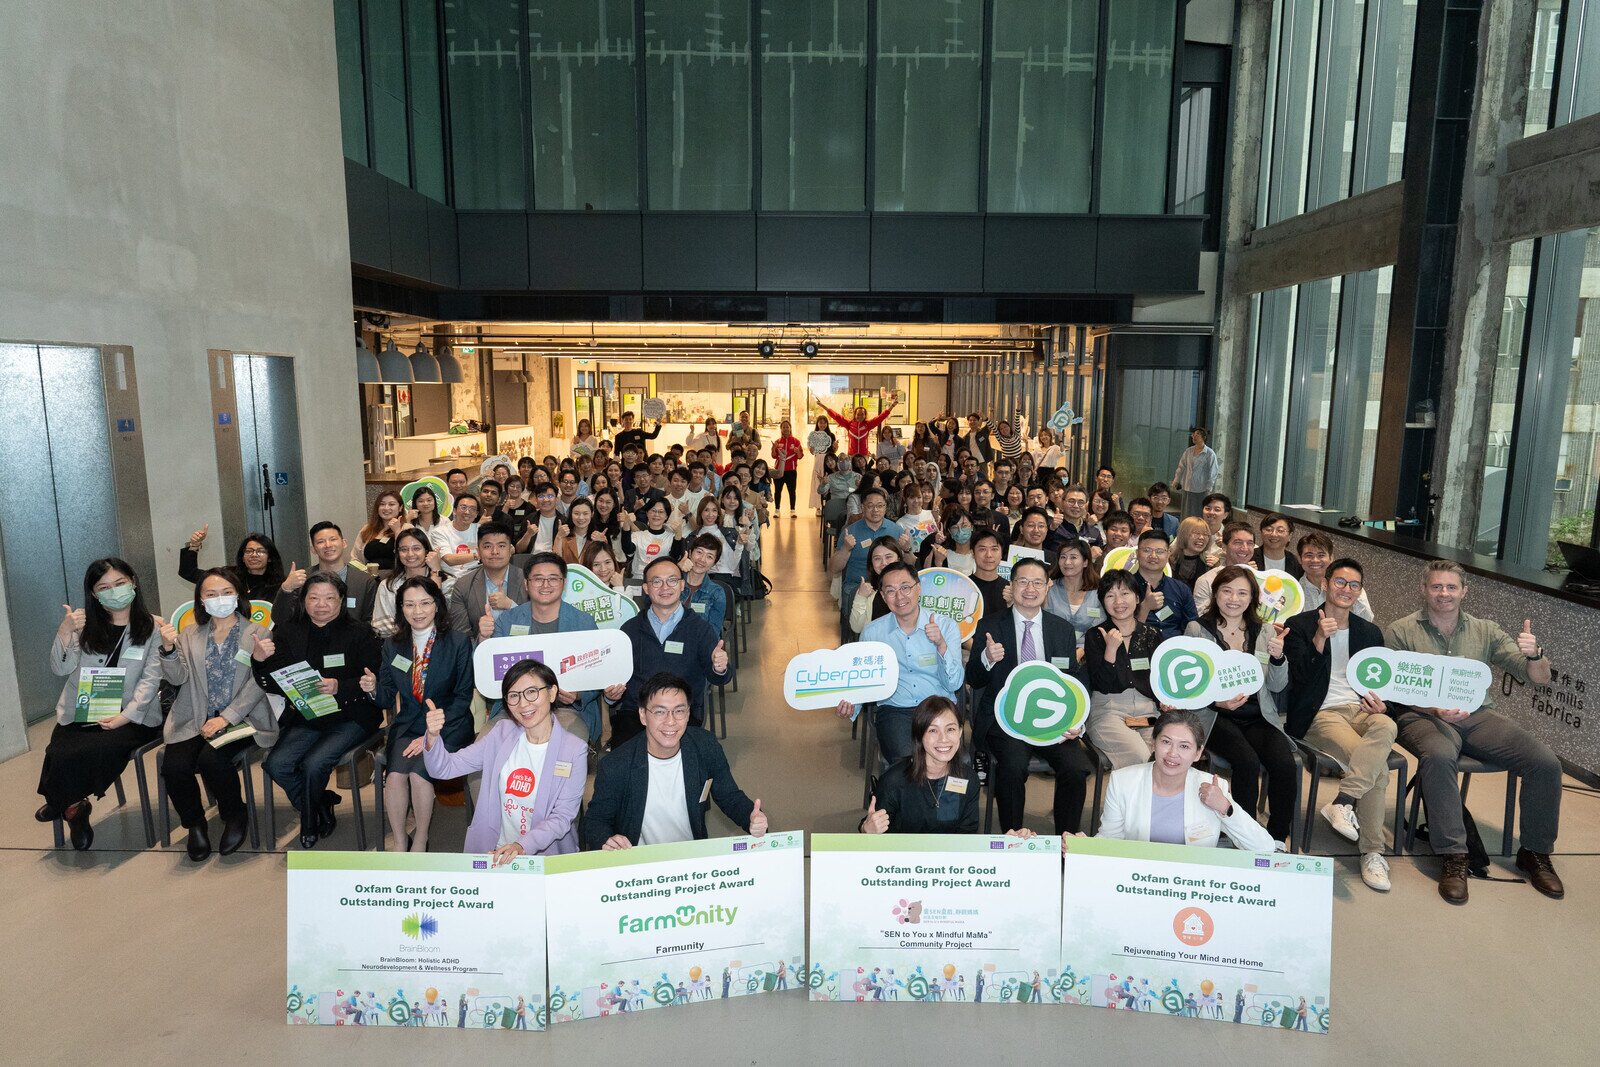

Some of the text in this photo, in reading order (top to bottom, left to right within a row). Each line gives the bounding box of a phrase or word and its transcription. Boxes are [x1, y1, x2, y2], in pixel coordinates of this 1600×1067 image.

[852, 655, 884, 666] 數碼港
[1218, 665, 1241, 676] GRANT
[1397, 662, 1434, 676] 樂施會
[796, 665, 887, 687] Cyberport
[1219, 669, 1256, 682] FOR GOOD
[1394, 674, 1432, 688] OXFAM
[1450, 678, 1469, 686] World
[1393, 685, 1428, 697] Hong Kong
[1448, 686, 1475, 695] Without
[1448, 693, 1473, 703] Poverty
[1556, 692, 1583, 710] mills
[1532, 694, 1581, 728] fabrica
[510, 780, 531, 792] ADHD
[875, 865, 996, 875] Oxfam Grant for Good
[615, 867, 740, 889] Oxfam Grant for Good
[861, 878, 1011, 889] Outstanding Project Award
[1131, 873, 1261, 893] Oxfam Grant for Good
[355, 884, 479, 896] Oxfam Grant for Good
[600, 878, 755, 903] Outstanding Project Award
[1116, 884, 1276, 907] Outstanding Project Award
[340, 898, 494, 910] Outstanding Project Award
[936, 931, 964, 939] Mindful
[399, 944, 441, 953] BrainBloom
[656, 941, 704, 954] Farmunity
[900, 940, 973, 949] Community Project
[1123, 946, 1263, 968] Rejuvenating Your Mind and Home
[453, 965, 478, 973] Program
